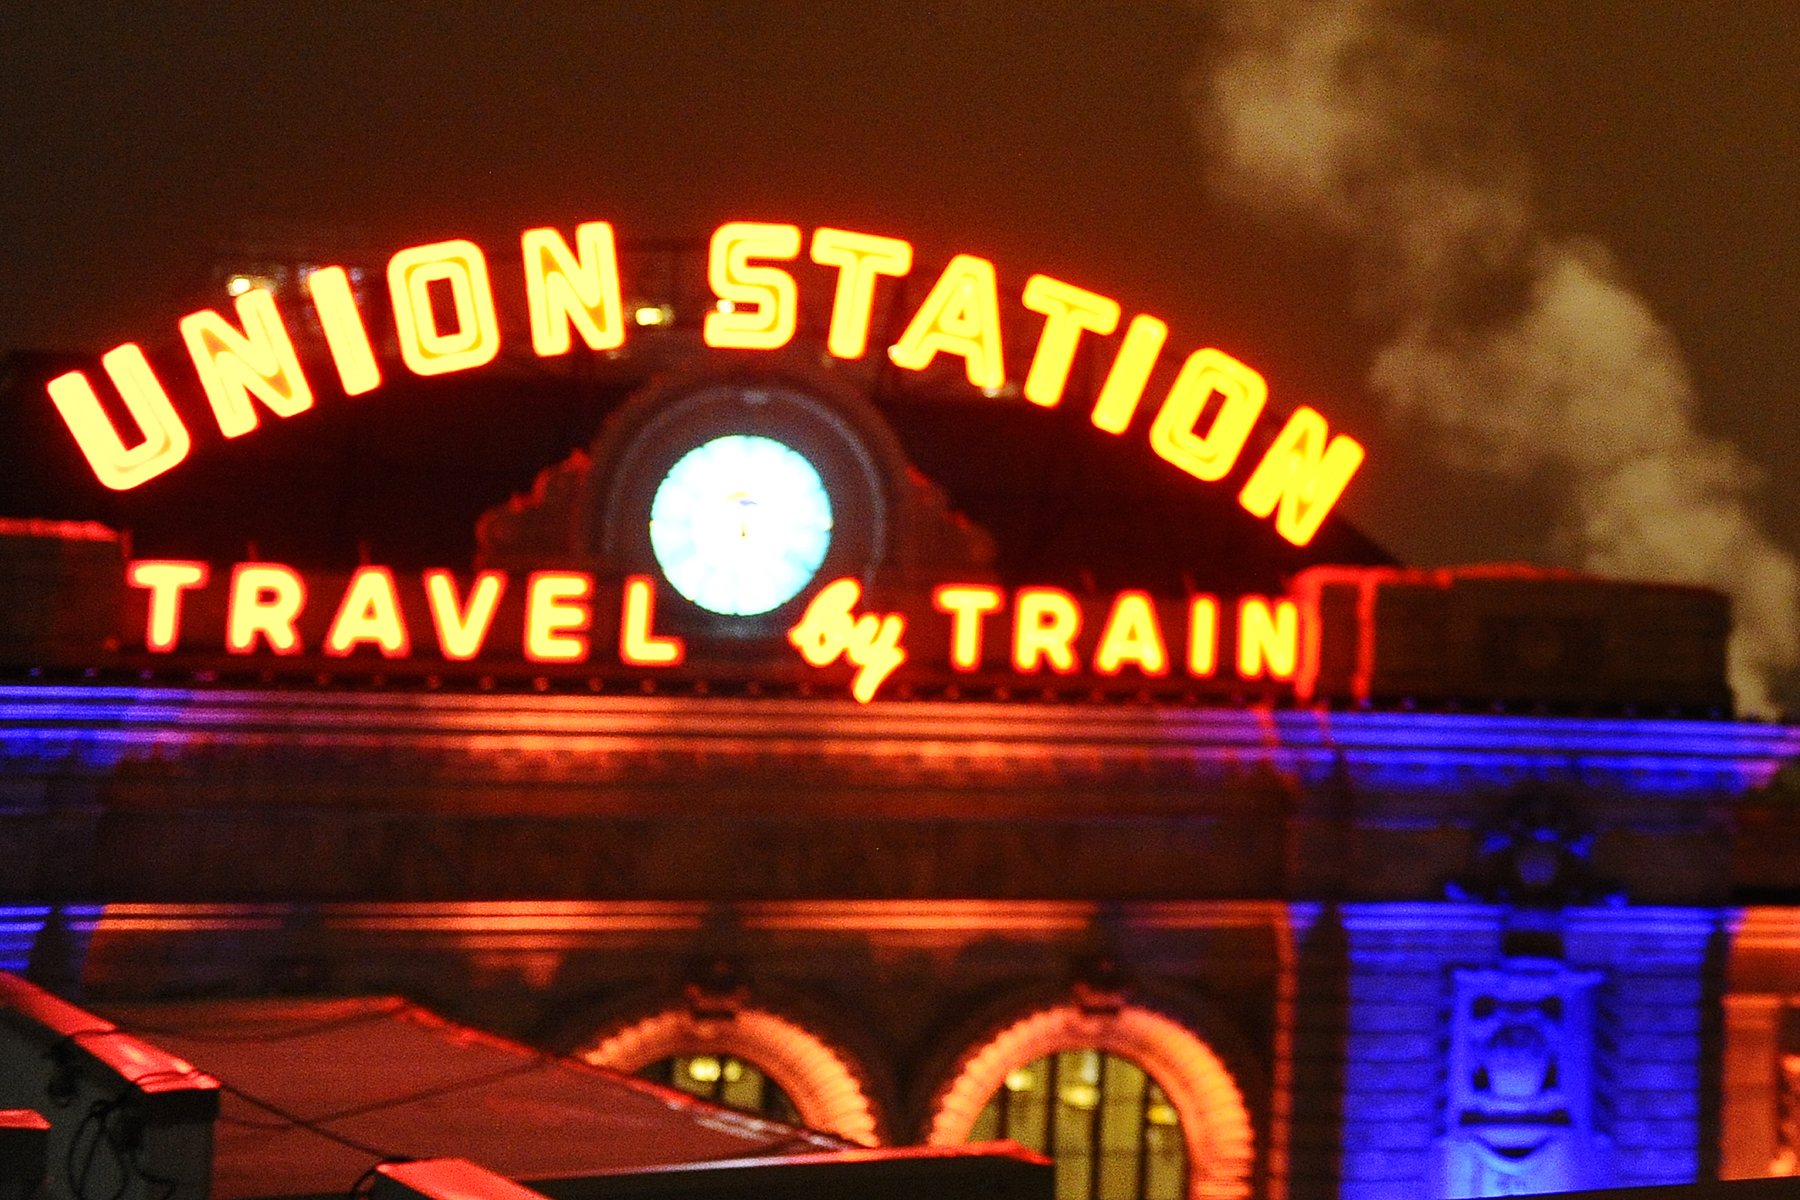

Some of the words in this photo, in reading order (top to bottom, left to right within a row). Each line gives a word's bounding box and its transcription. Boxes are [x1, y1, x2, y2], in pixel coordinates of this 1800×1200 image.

[48, 221, 625, 491] UNION
[703, 221, 1365, 547] STATION
[128, 561, 687, 665] TRAVEL
[790, 578, 906, 703] by
[934, 584, 1299, 679] TRAIN
